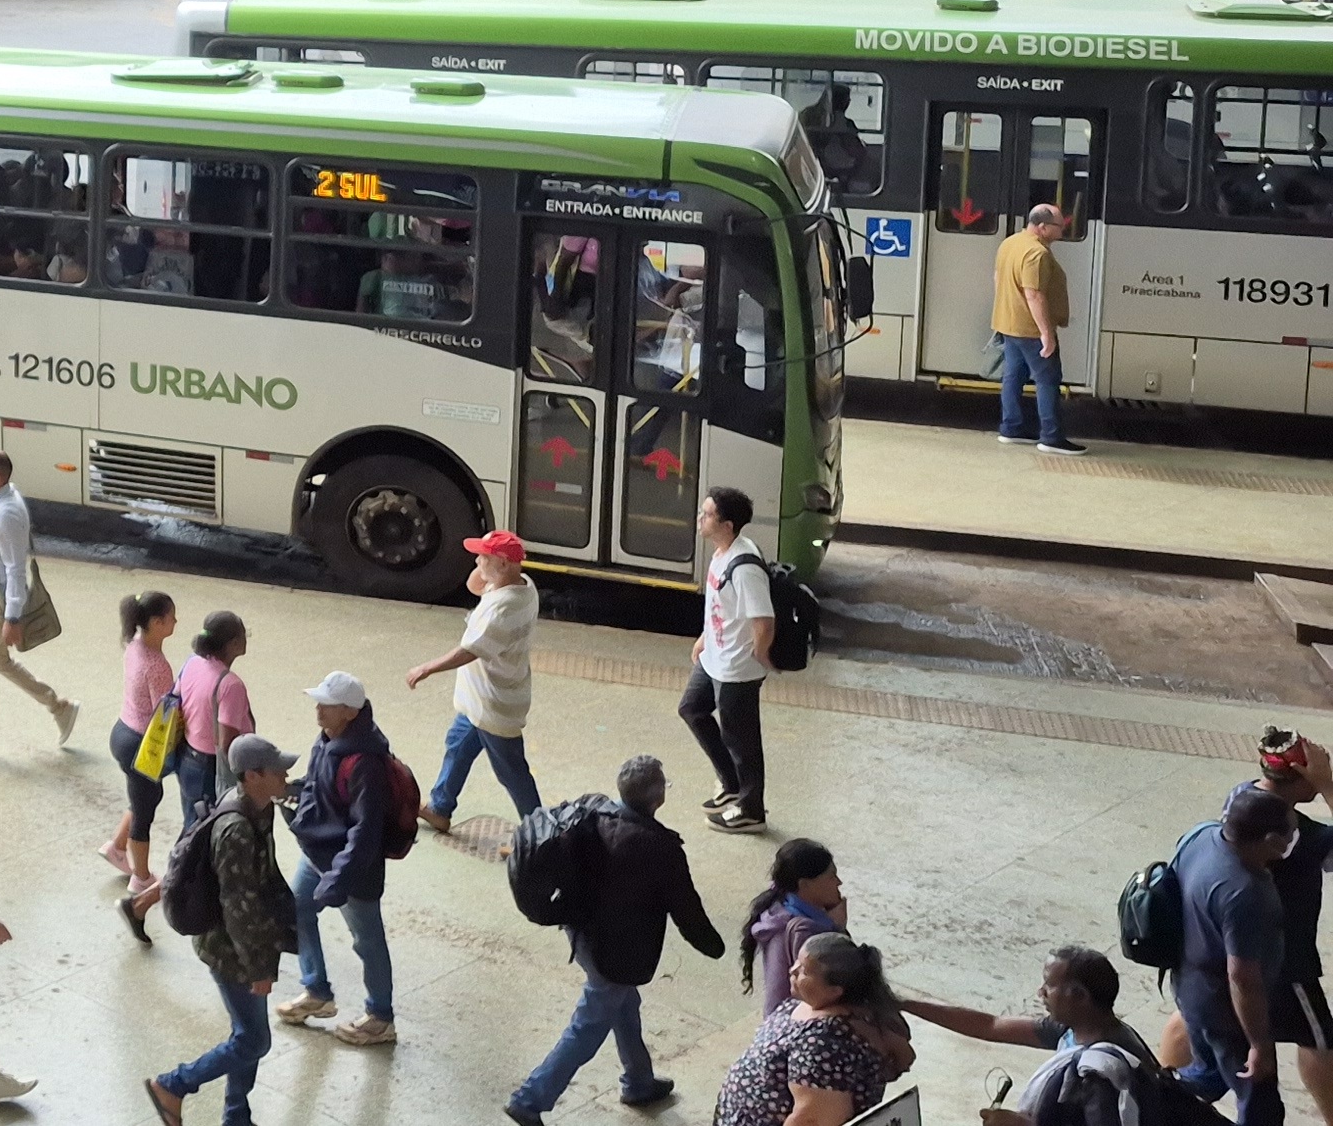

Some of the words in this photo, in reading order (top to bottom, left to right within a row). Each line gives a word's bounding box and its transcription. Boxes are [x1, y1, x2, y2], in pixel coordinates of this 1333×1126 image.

[855, 28, 979, 55] MOVIDO
[985, 33, 1008, 55] A
[1017, 34, 1189, 62] BIODIESEL
[431, 55, 469, 70] SAÍDA
[477, 58, 507, 71] EXIT
[976, 74, 1021, 90] SAÍDA
[1031, 78, 1064, 92] EXIT
[339, 171, 388, 202] SUL
[545, 198, 613, 216] ENTRADA
[622, 205, 704, 224] ENTRANCE
[1121, 284, 1201, 300] Piracicabana
[1141, 270, 1174, 285] Área
[1178, 275, 1184, 286] 1
[1216, 276, 1331, 308] 118931
[373, 326, 483, 349] MASCARELLO
[7, 352, 116, 390] 121606
[129, 361, 298, 411] URBANO
